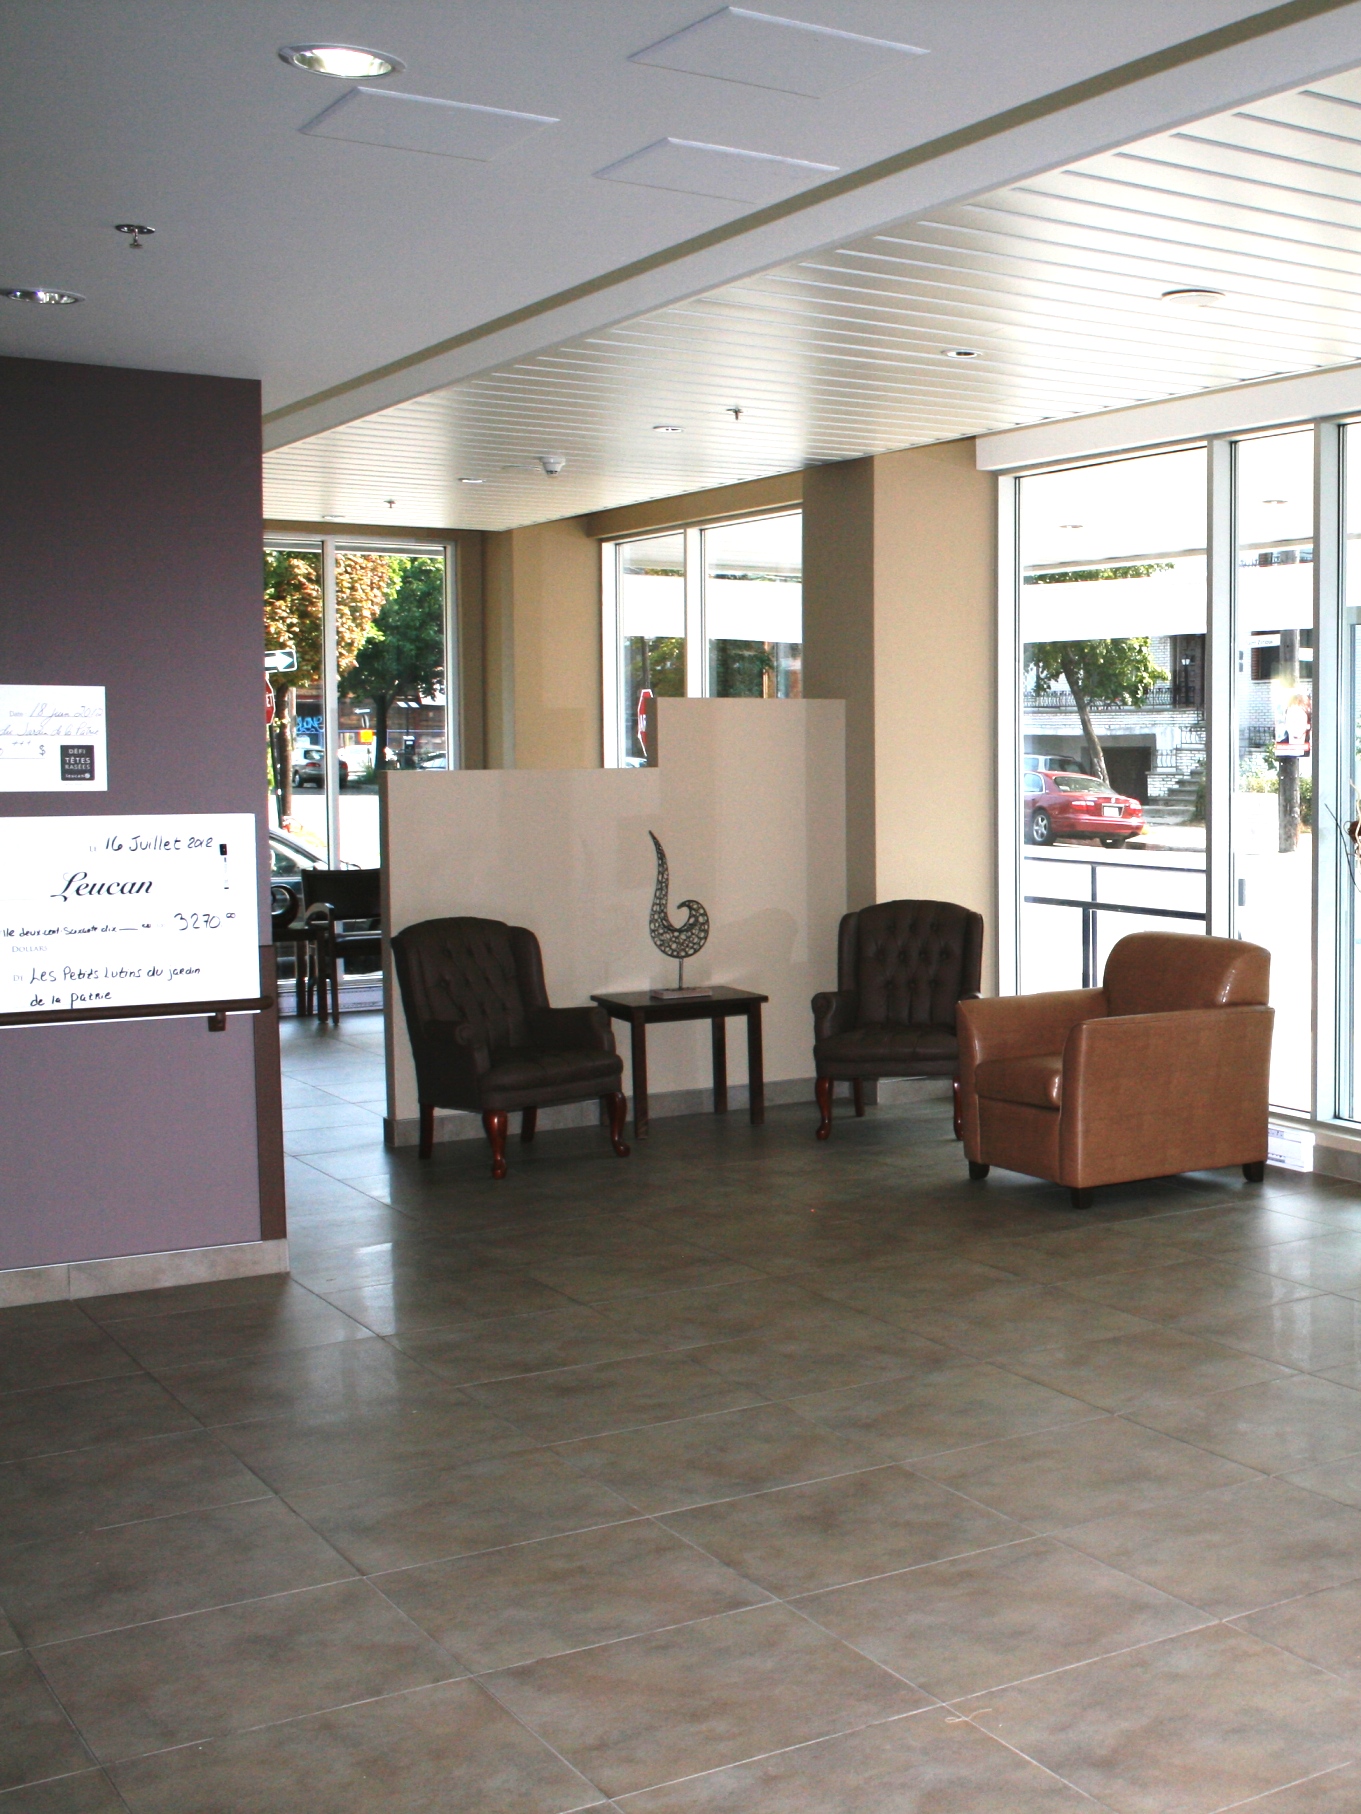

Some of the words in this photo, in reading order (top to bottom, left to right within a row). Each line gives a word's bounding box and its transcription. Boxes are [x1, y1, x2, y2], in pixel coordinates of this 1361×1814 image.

[106, 836, 123, 851] 16
[187, 837, 213, 849] 2012
[50, 871, 153, 903] Leucan
[30, 967, 57, 985] Les
[63, 965, 99, 981] Petits
[147, 966, 164, 978] du
[30, 994, 46, 1007] de
[52, 995, 61, 1004] la
